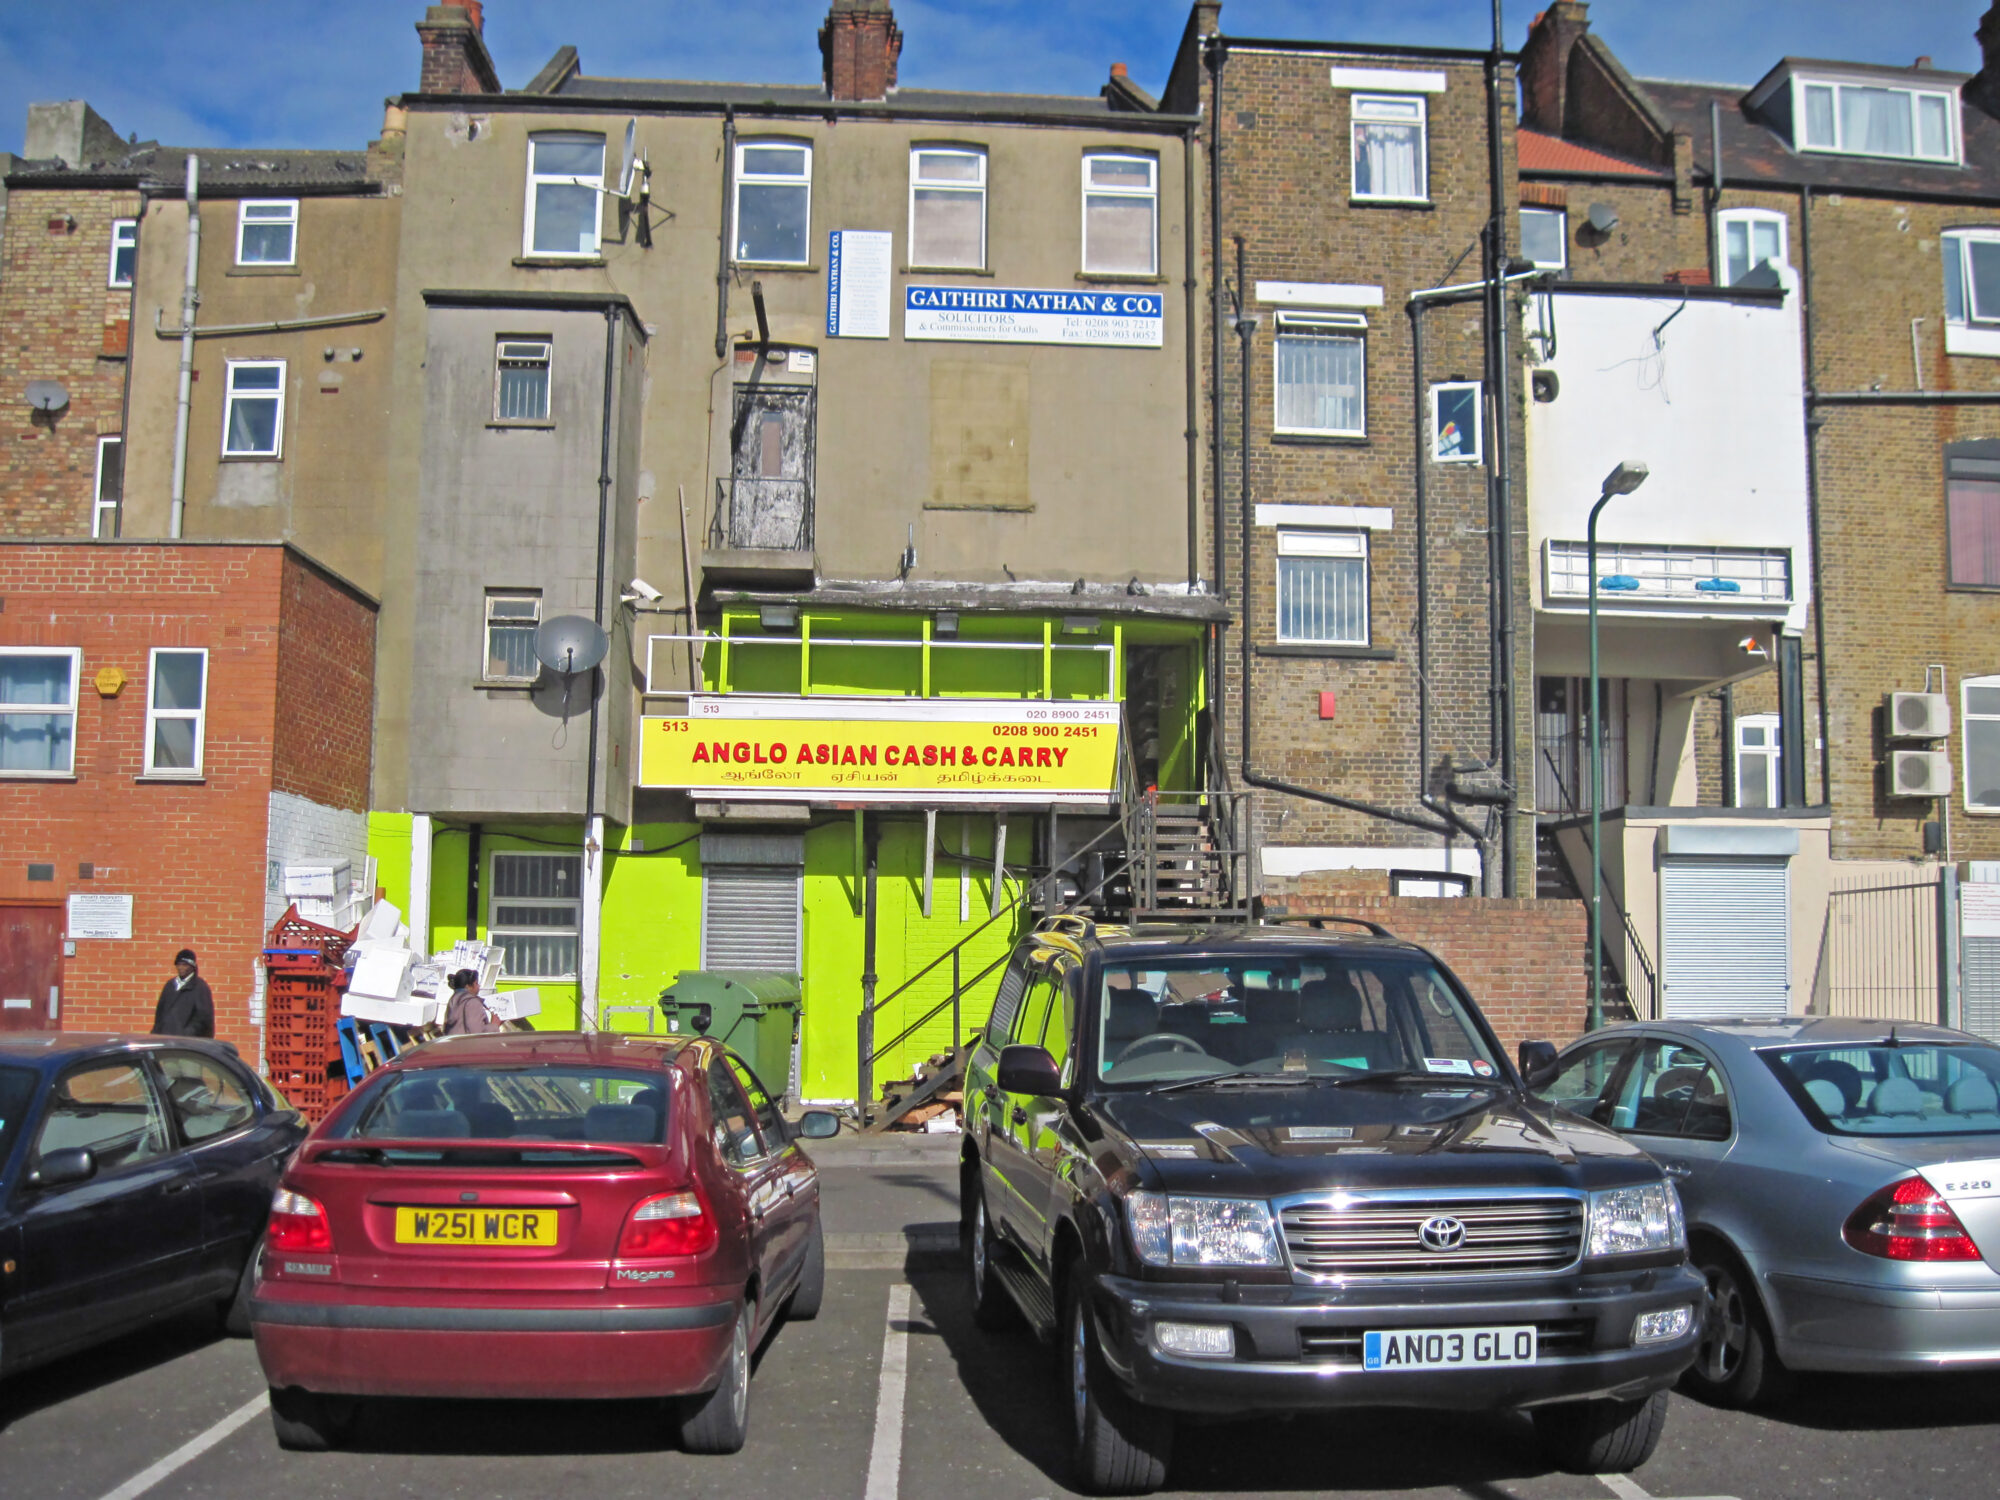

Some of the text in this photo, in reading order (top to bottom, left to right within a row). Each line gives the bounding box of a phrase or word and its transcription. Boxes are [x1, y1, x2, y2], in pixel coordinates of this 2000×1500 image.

[831, 258, 839, 292] NATHAN
[910, 290, 1157, 314] GAITHIRI NATHAN & CO.
[829, 293, 838, 333] GAITHIRI
[938, 312, 1015, 324] SOLICITORS
[930, 322, 997, 333] Commissioners
[999, 323, 1010, 332] for
[1013, 325, 1038, 334] Oaths
[1085, 318, 1109, 327] 0208
[1112, 319, 1129, 328] 903
[1086, 328, 1109, 338] 0208
[703, 705, 1110, 719] 513 020 8900 2451
[662, 721, 1098, 737] 513 0208 900 2451
[692, 742, 787, 764] ANGLO
[796, 743, 877, 765] ASIAN
[1945, 1180, 1991, 1191] E 220
[414, 1212, 539, 1239] W251 WCR
[616, 1269, 675, 1283] Mégane
[1385, 1331, 1532, 1365] AN03 GLO
[1367, 1357, 1380, 1365] GB
